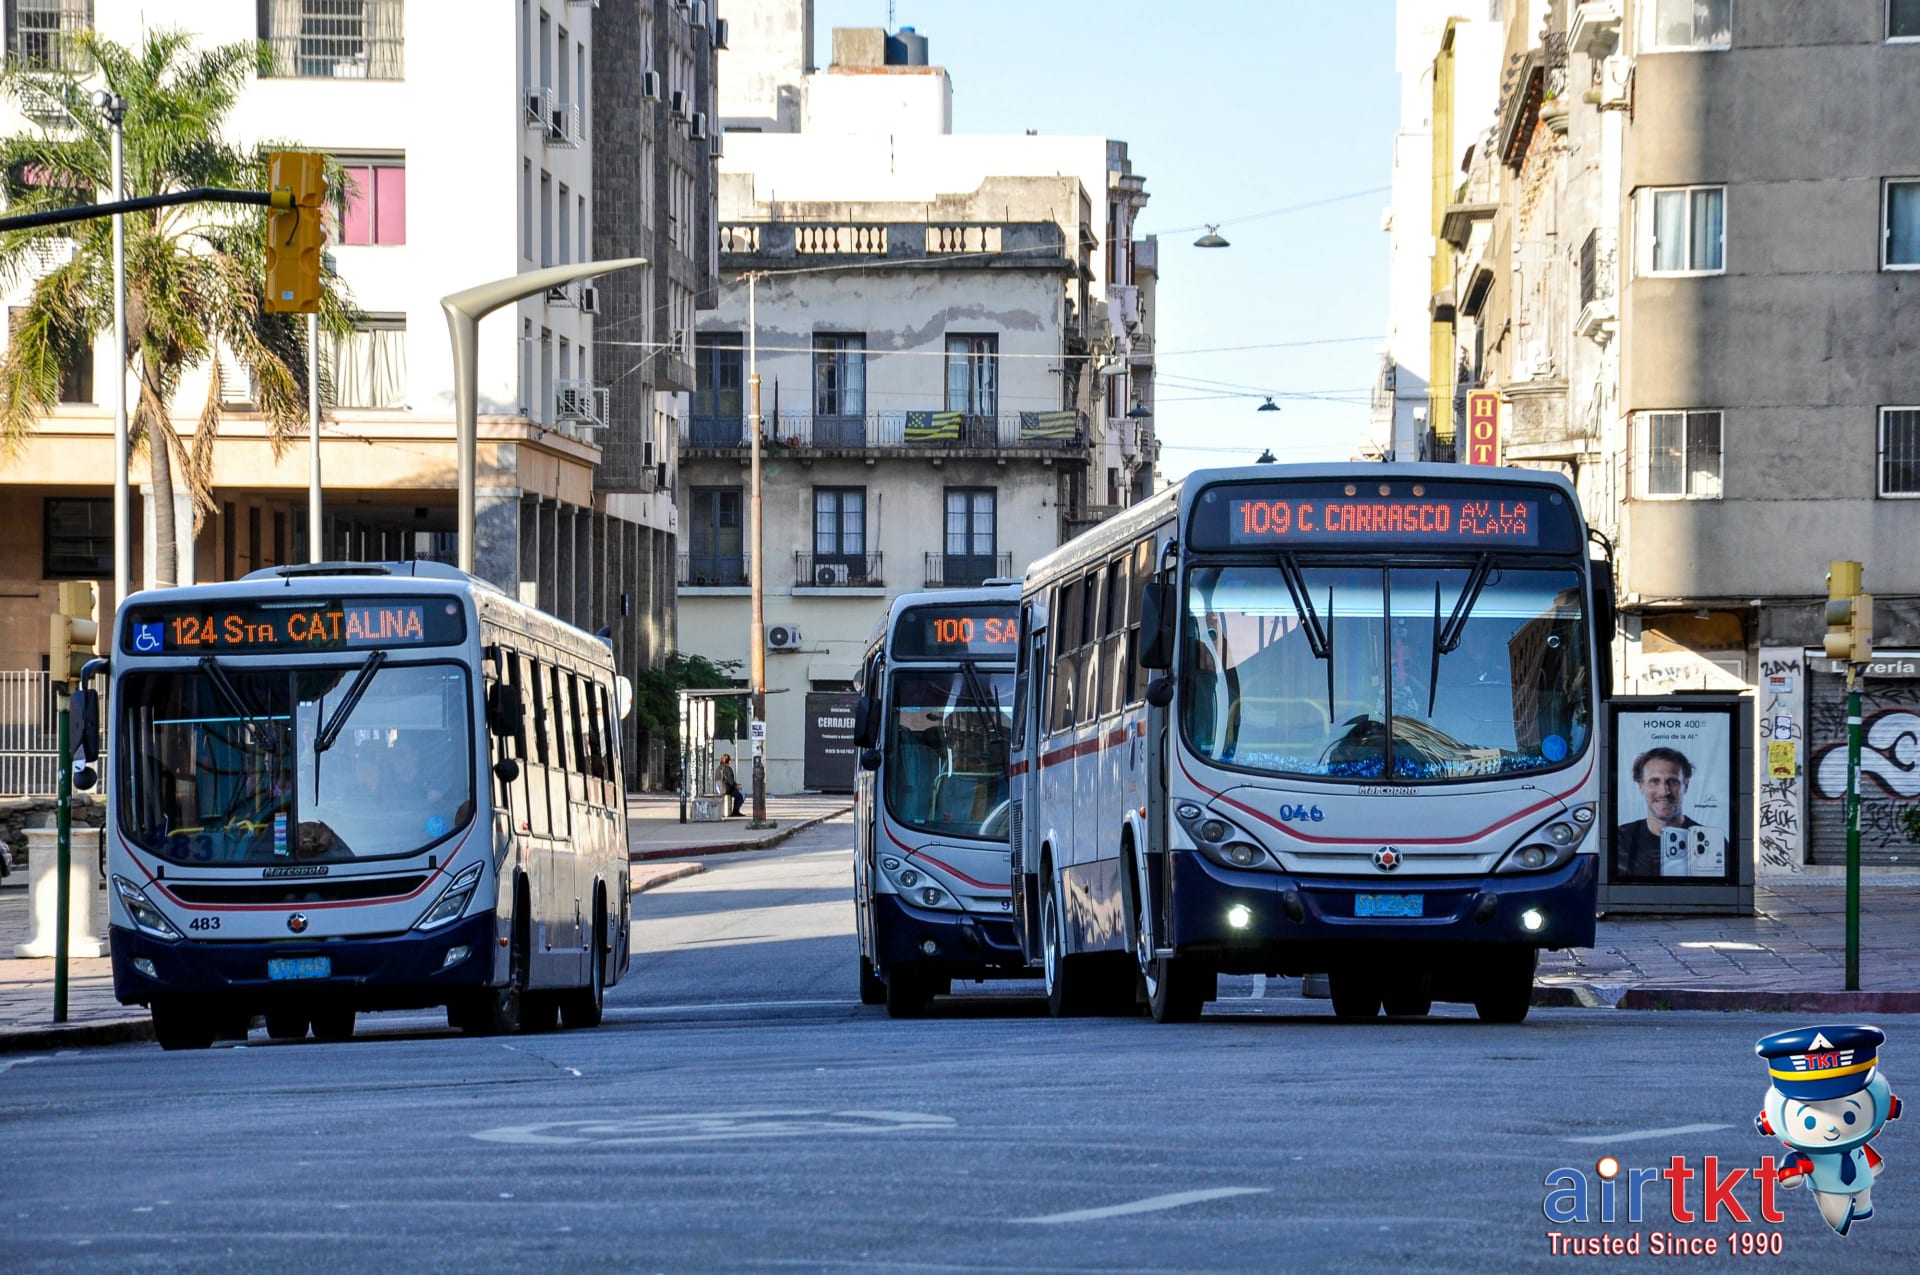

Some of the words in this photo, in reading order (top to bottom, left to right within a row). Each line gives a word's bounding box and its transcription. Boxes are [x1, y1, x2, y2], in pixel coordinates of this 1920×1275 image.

[1241, 502, 1291, 533] 109
[1298, 504, 1319, 531] C.
[1325, 504, 1450, 531] CARRASCO
[1459, 519, 1527, 534] PLAYA
[172, 616, 217, 645] 124
[287, 609, 423, 641] CATALINA
[934, 618, 974, 642] 100
[1832, 660, 1915, 673] Lrería
[1643, 720, 1681, 728] HONOR
[1684, 720, 1700, 728] 400
[1359, 786, 1417, 796] Marcopolo
[1279, 804, 1324, 822] 046
[264, 866, 328, 877] Marcopolo
[189, 917, 221, 930] 483
